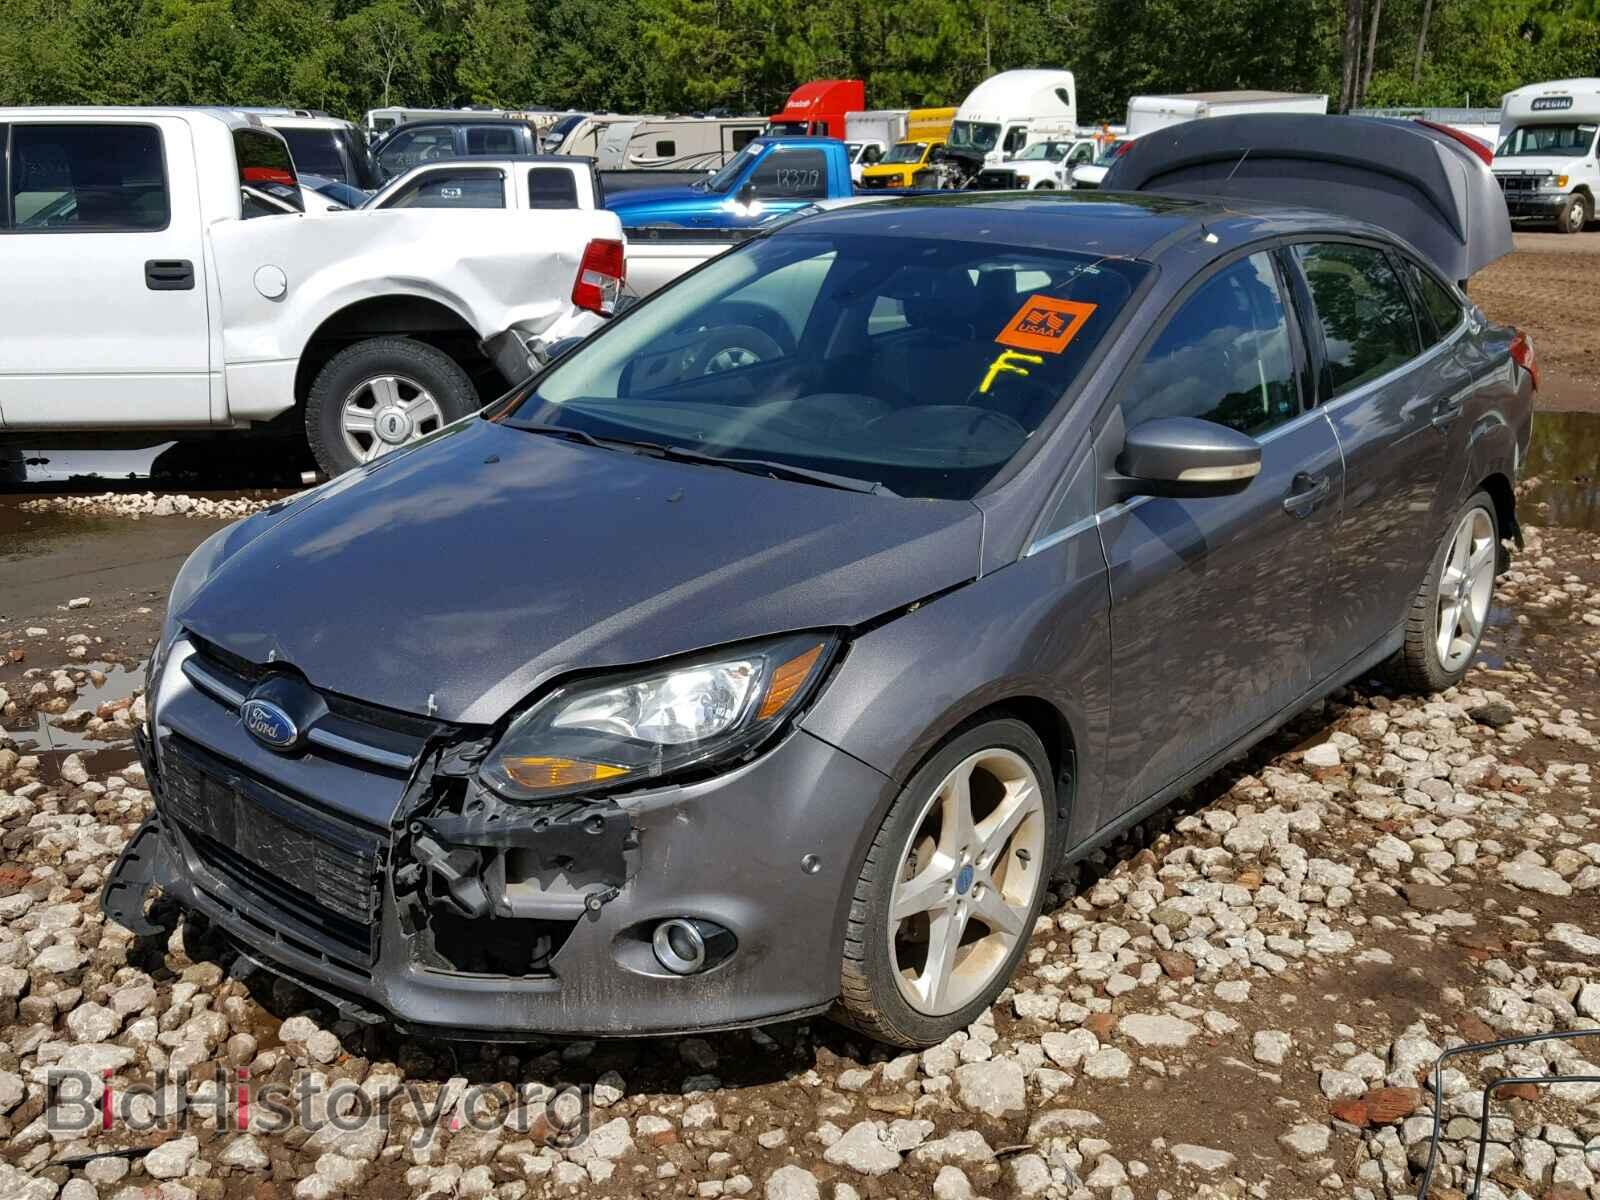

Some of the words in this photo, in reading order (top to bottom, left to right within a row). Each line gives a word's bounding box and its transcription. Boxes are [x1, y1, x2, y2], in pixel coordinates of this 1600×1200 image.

[1534, 99, 1570, 109] SPECIAL
[1018, 323, 1055, 337] USAA
[979, 349, 1044, 393] F
[249, 707, 280, 738] Ford
